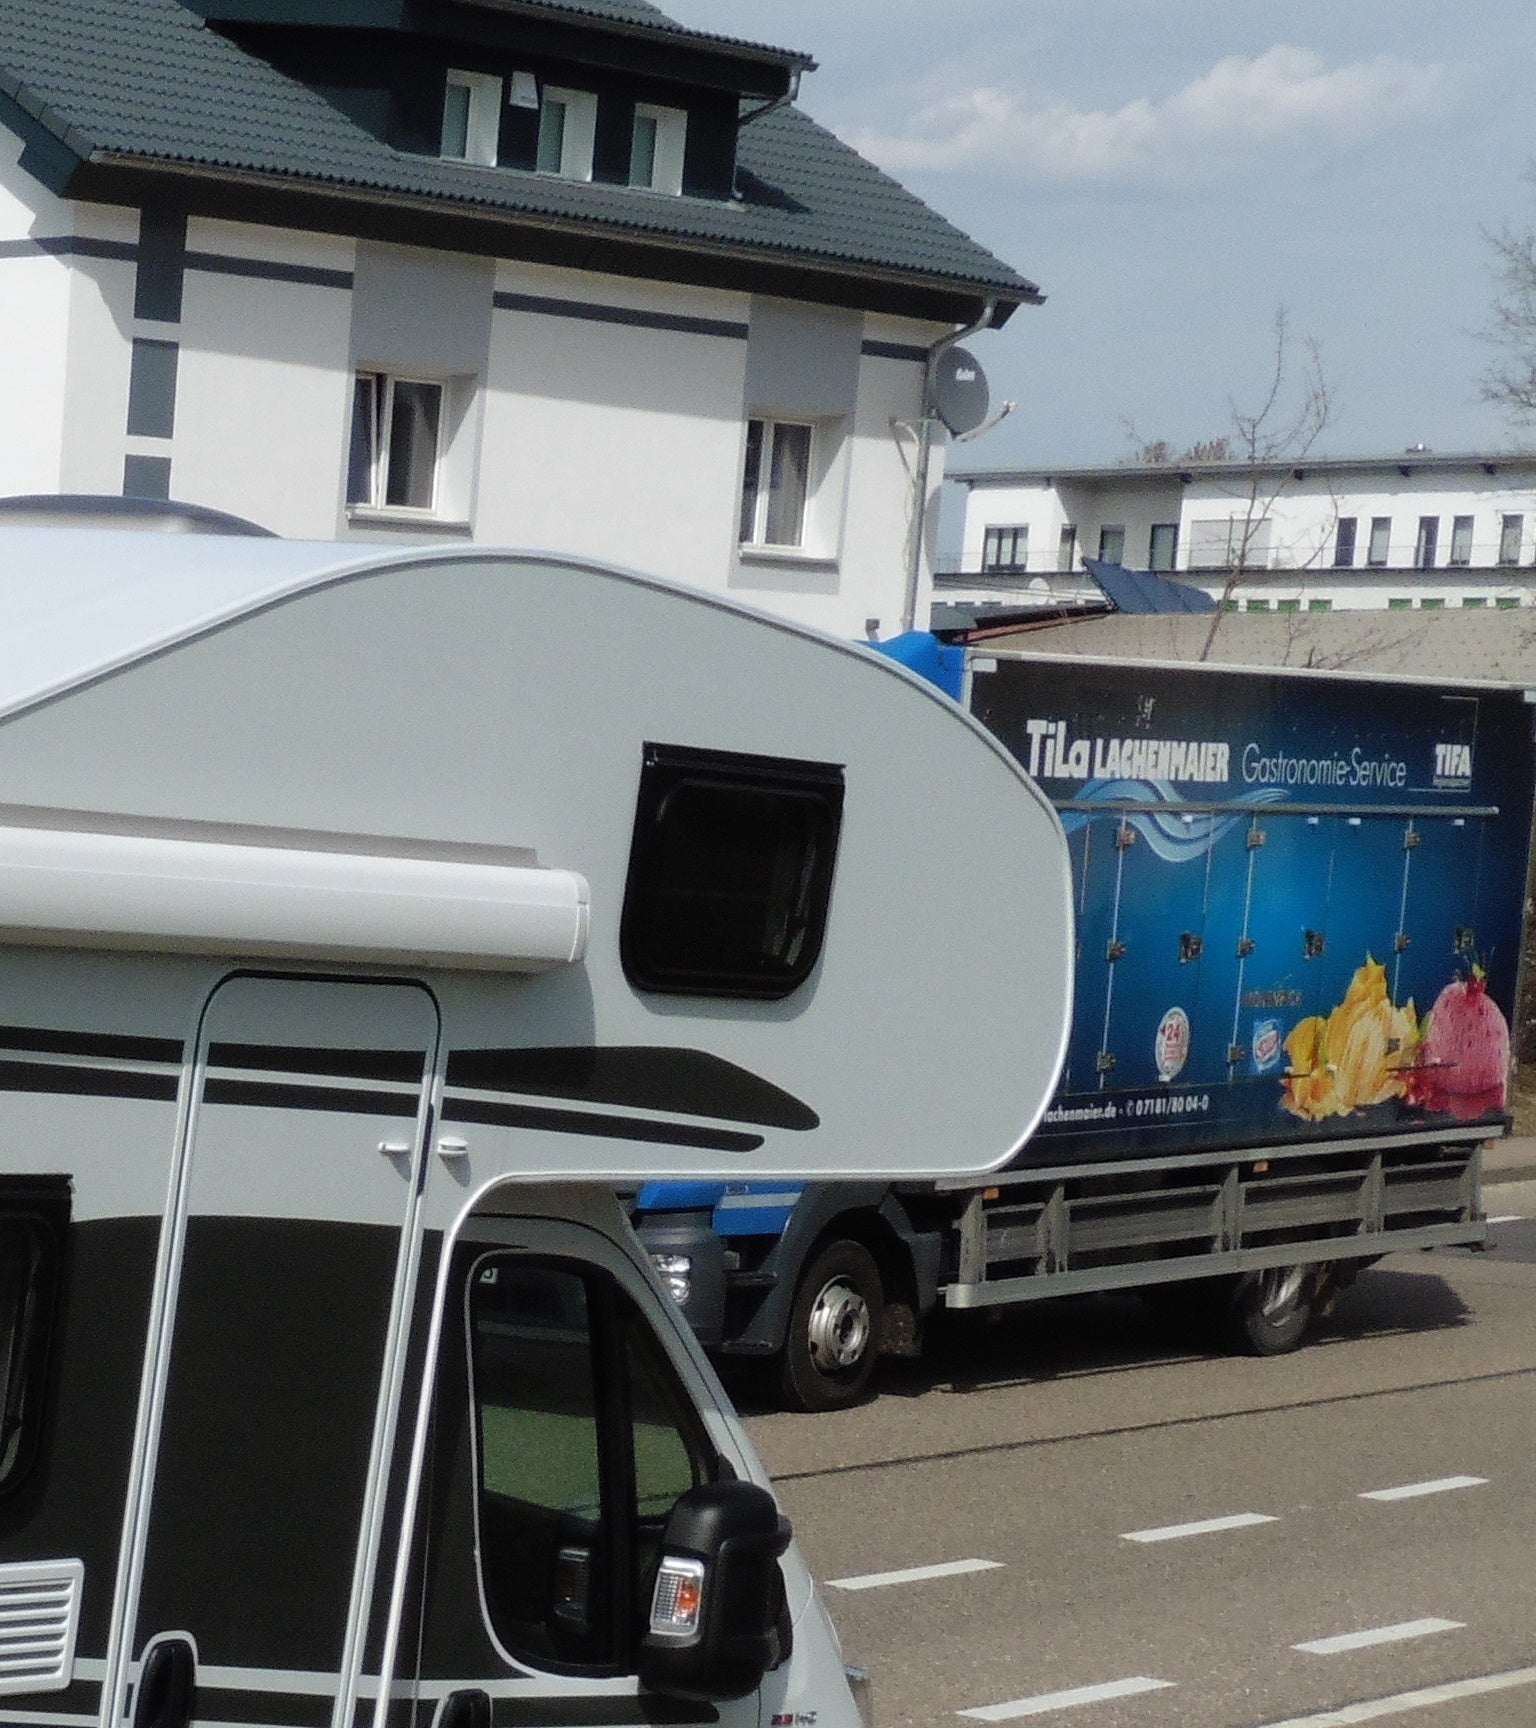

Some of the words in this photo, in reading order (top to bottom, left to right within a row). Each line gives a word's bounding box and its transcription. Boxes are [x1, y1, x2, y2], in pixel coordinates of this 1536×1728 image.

[1094, 738, 1230, 783] LACHENMAIER
[1241, 742, 1407, 788] Gastronomie-Service
[1435, 743, 1471, 777] TIFA
